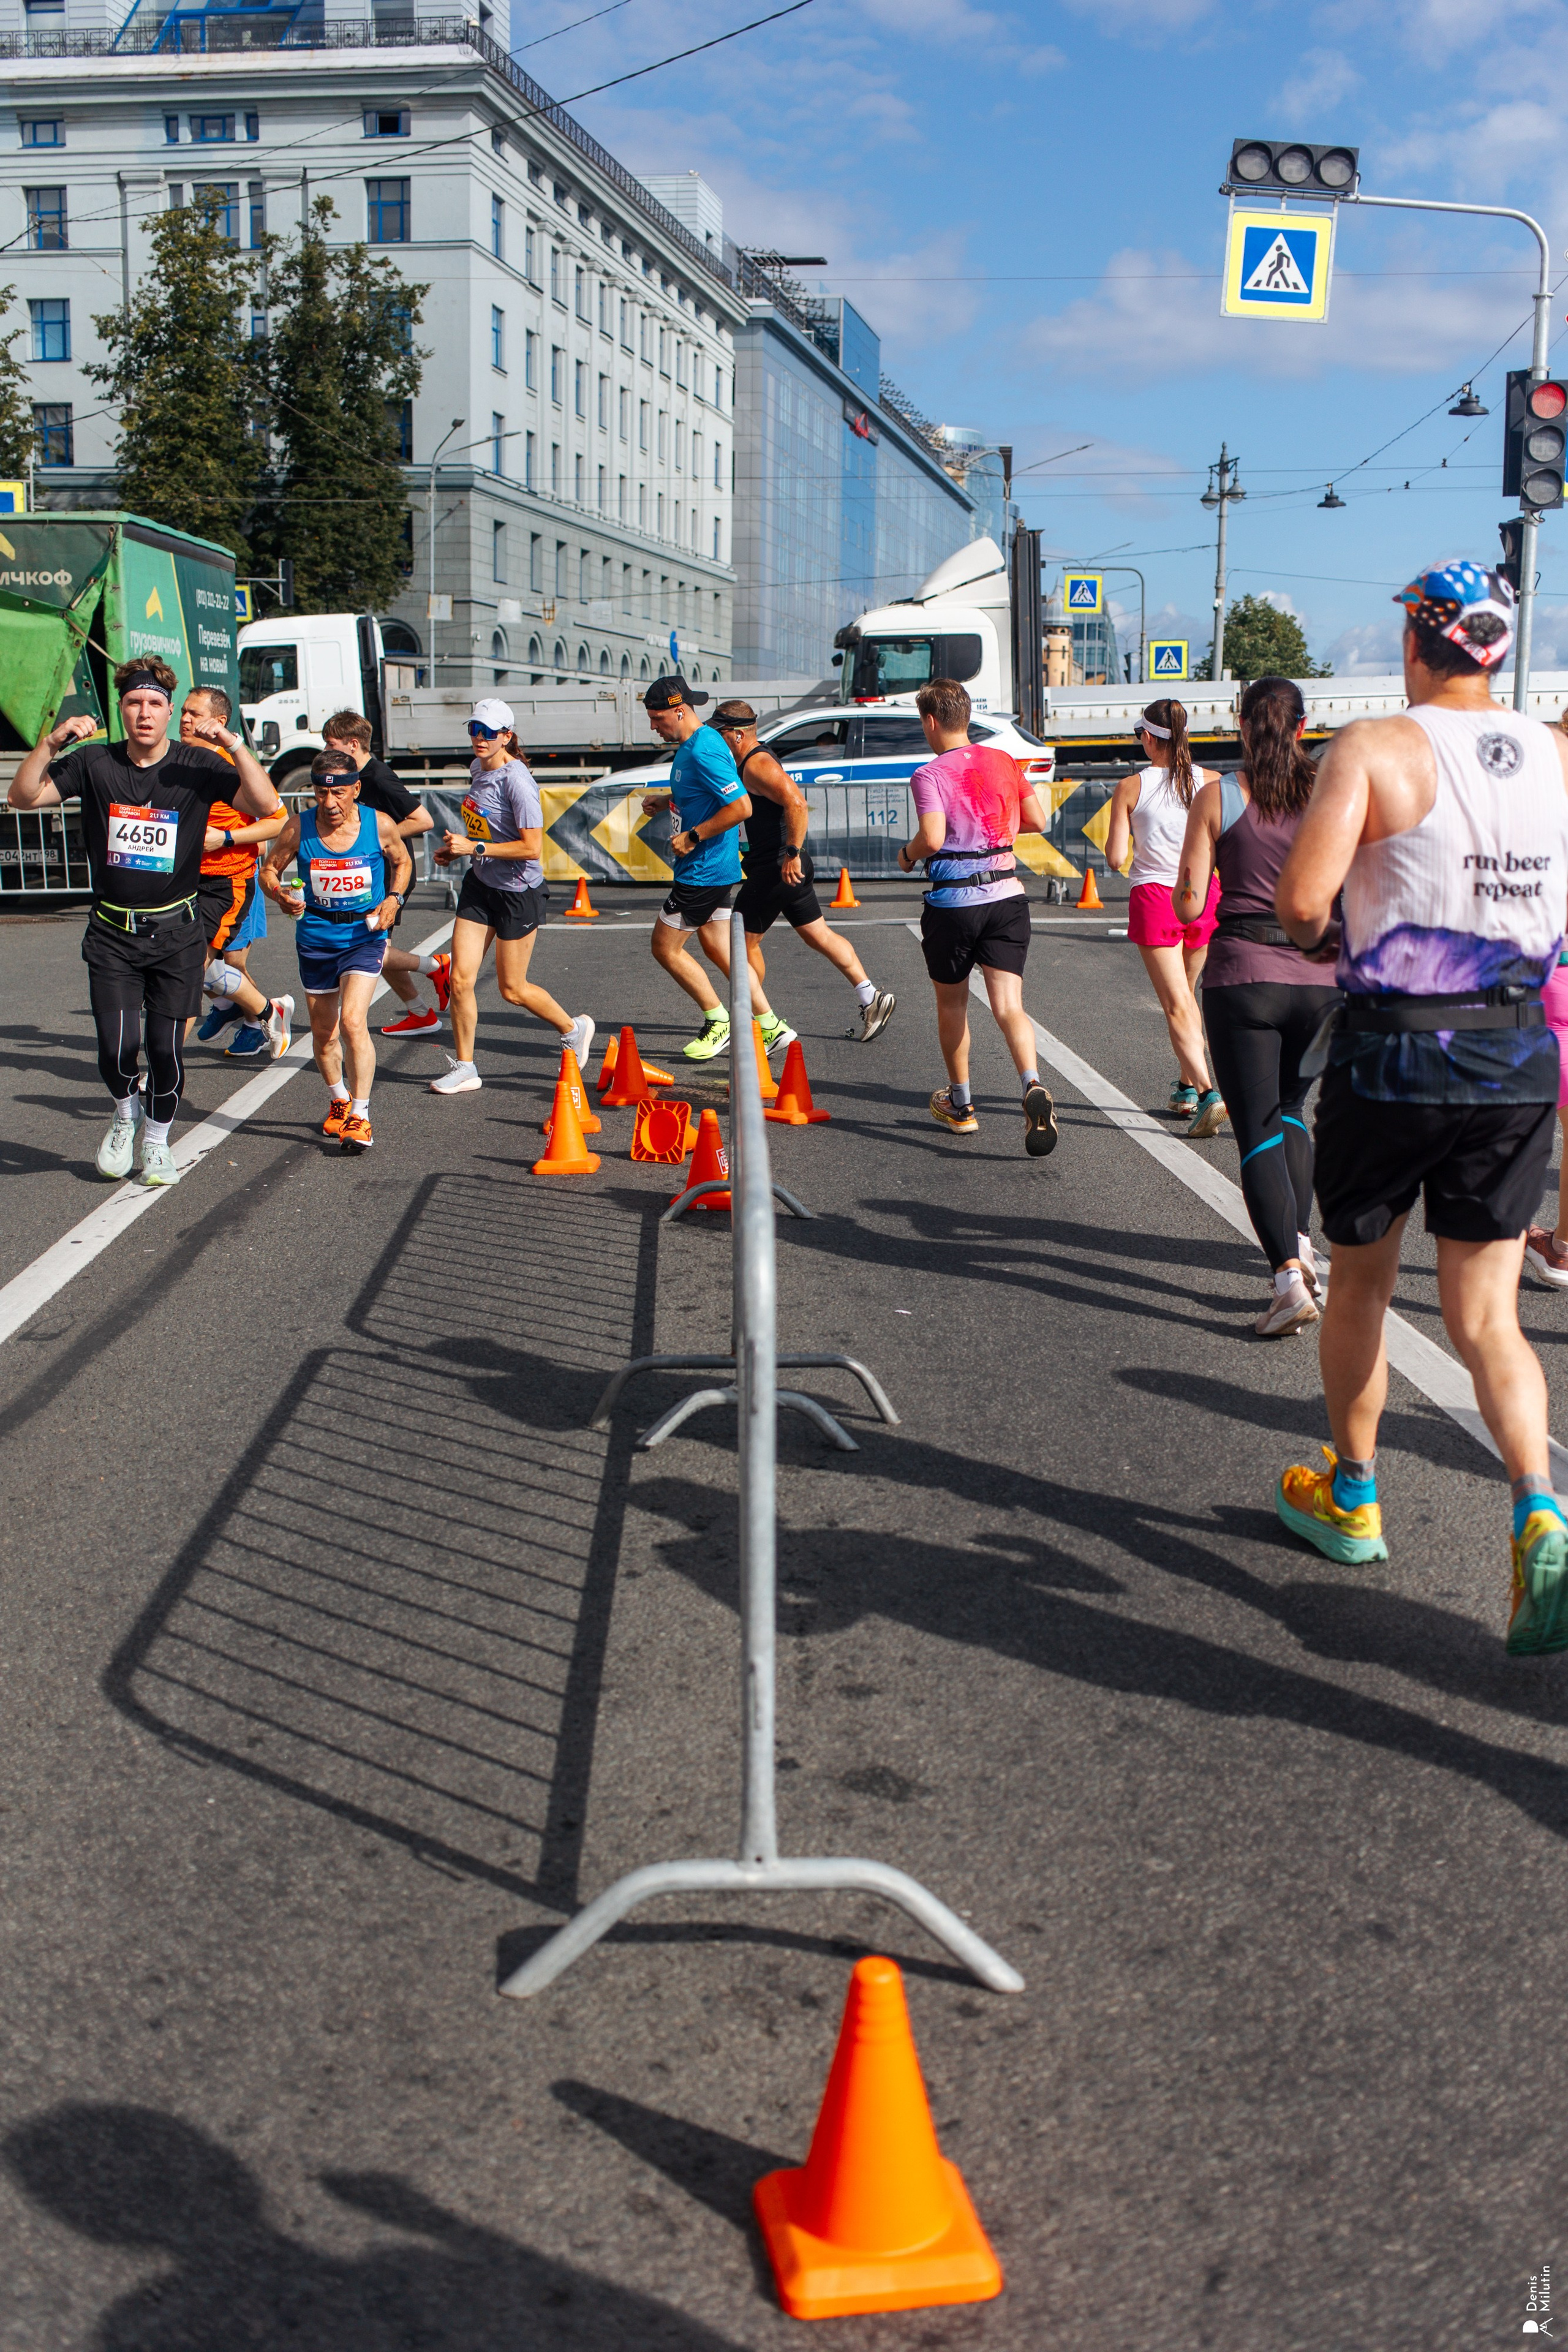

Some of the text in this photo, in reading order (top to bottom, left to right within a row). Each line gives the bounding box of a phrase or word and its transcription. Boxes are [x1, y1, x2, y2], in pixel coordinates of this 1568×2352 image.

[130, 630, 181, 658] грузовичкоф
[198, 624, 231, 650] Перевезём
[200, 654, 228, 674] на новый
[868, 810, 898, 825] 112
[116, 823, 167, 846] 4650
[113, 853, 121, 864] D
[1463, 851, 1551, 872] run beer
[319, 876, 364, 892] 7258
[1474, 880, 1542, 902] repeat
